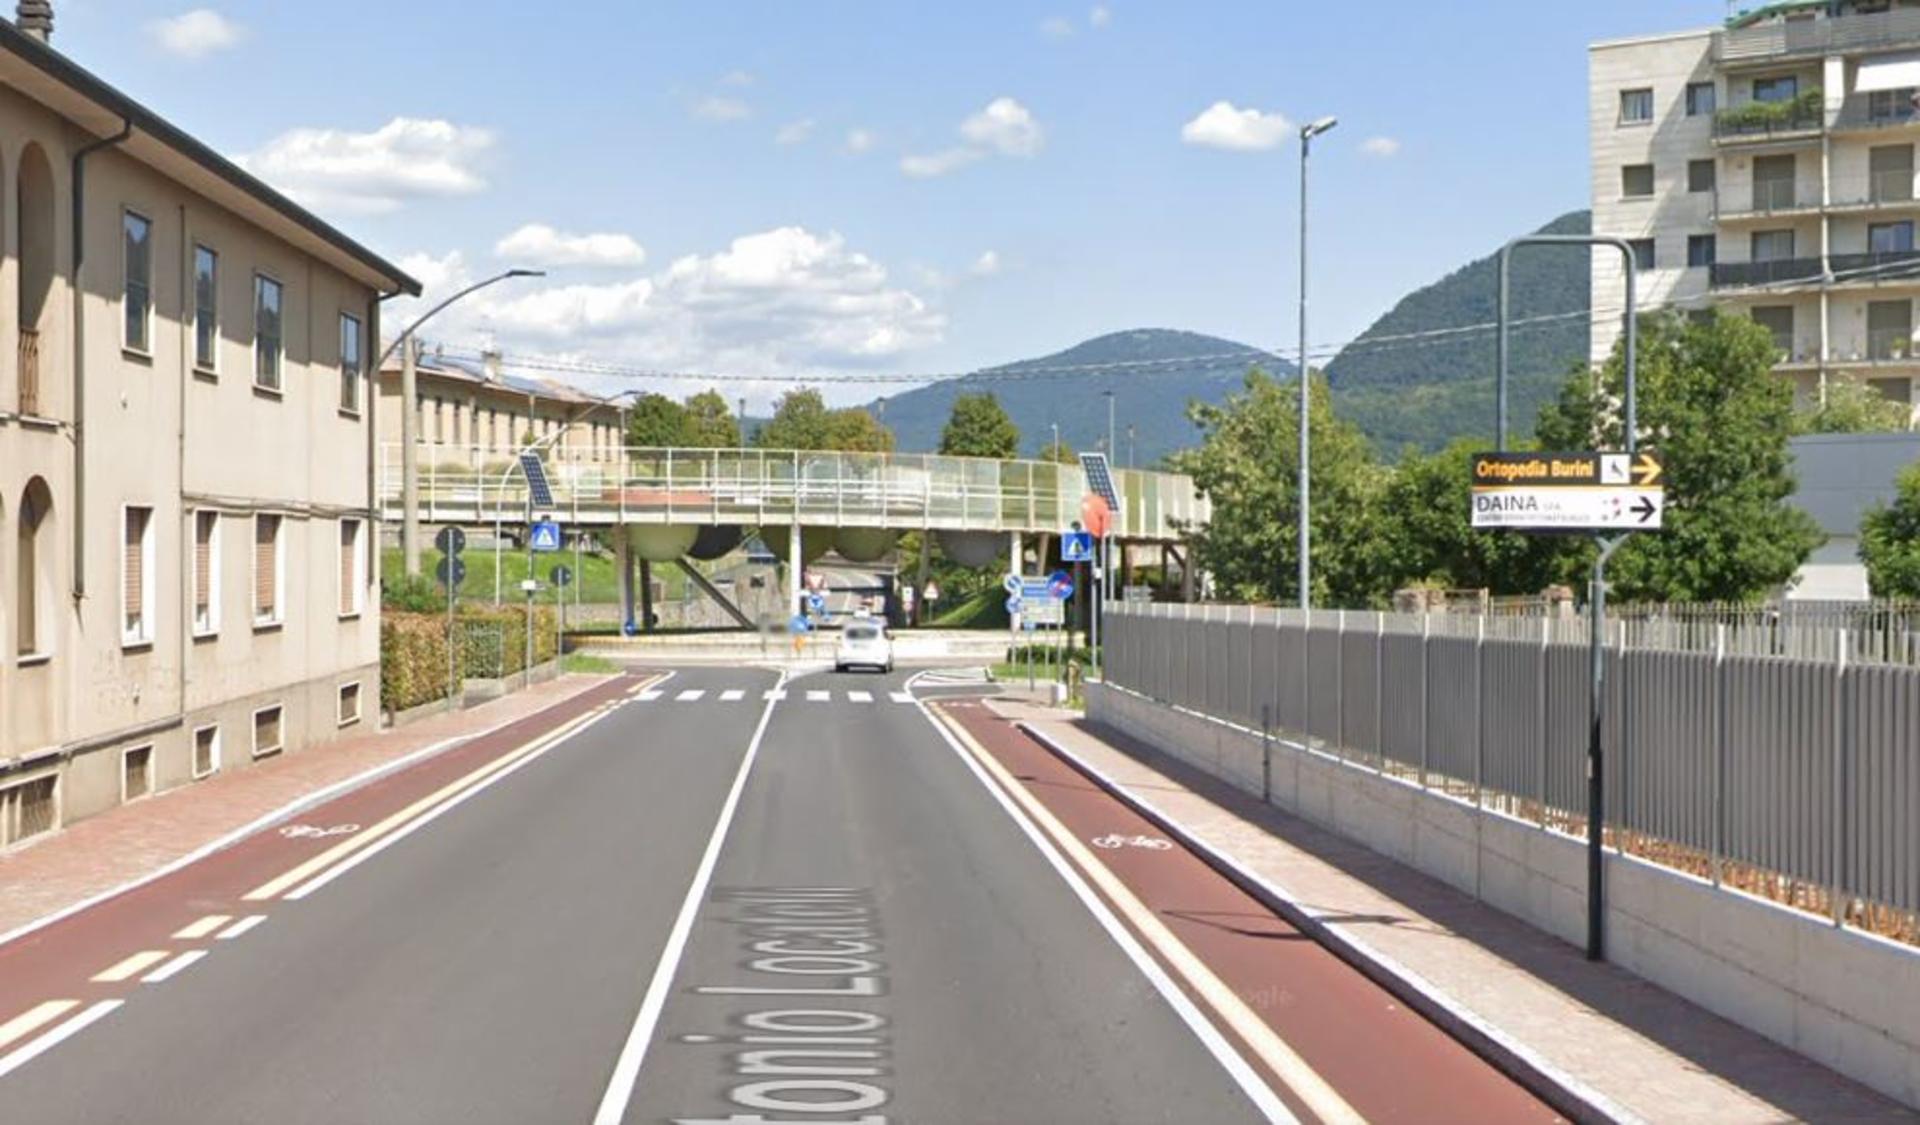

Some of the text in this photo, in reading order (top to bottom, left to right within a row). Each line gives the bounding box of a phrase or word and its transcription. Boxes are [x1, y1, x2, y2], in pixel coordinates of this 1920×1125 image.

[1477, 459, 1594, 481] Ortopedia Burini
[1477, 495, 1538, 512] DAINA
